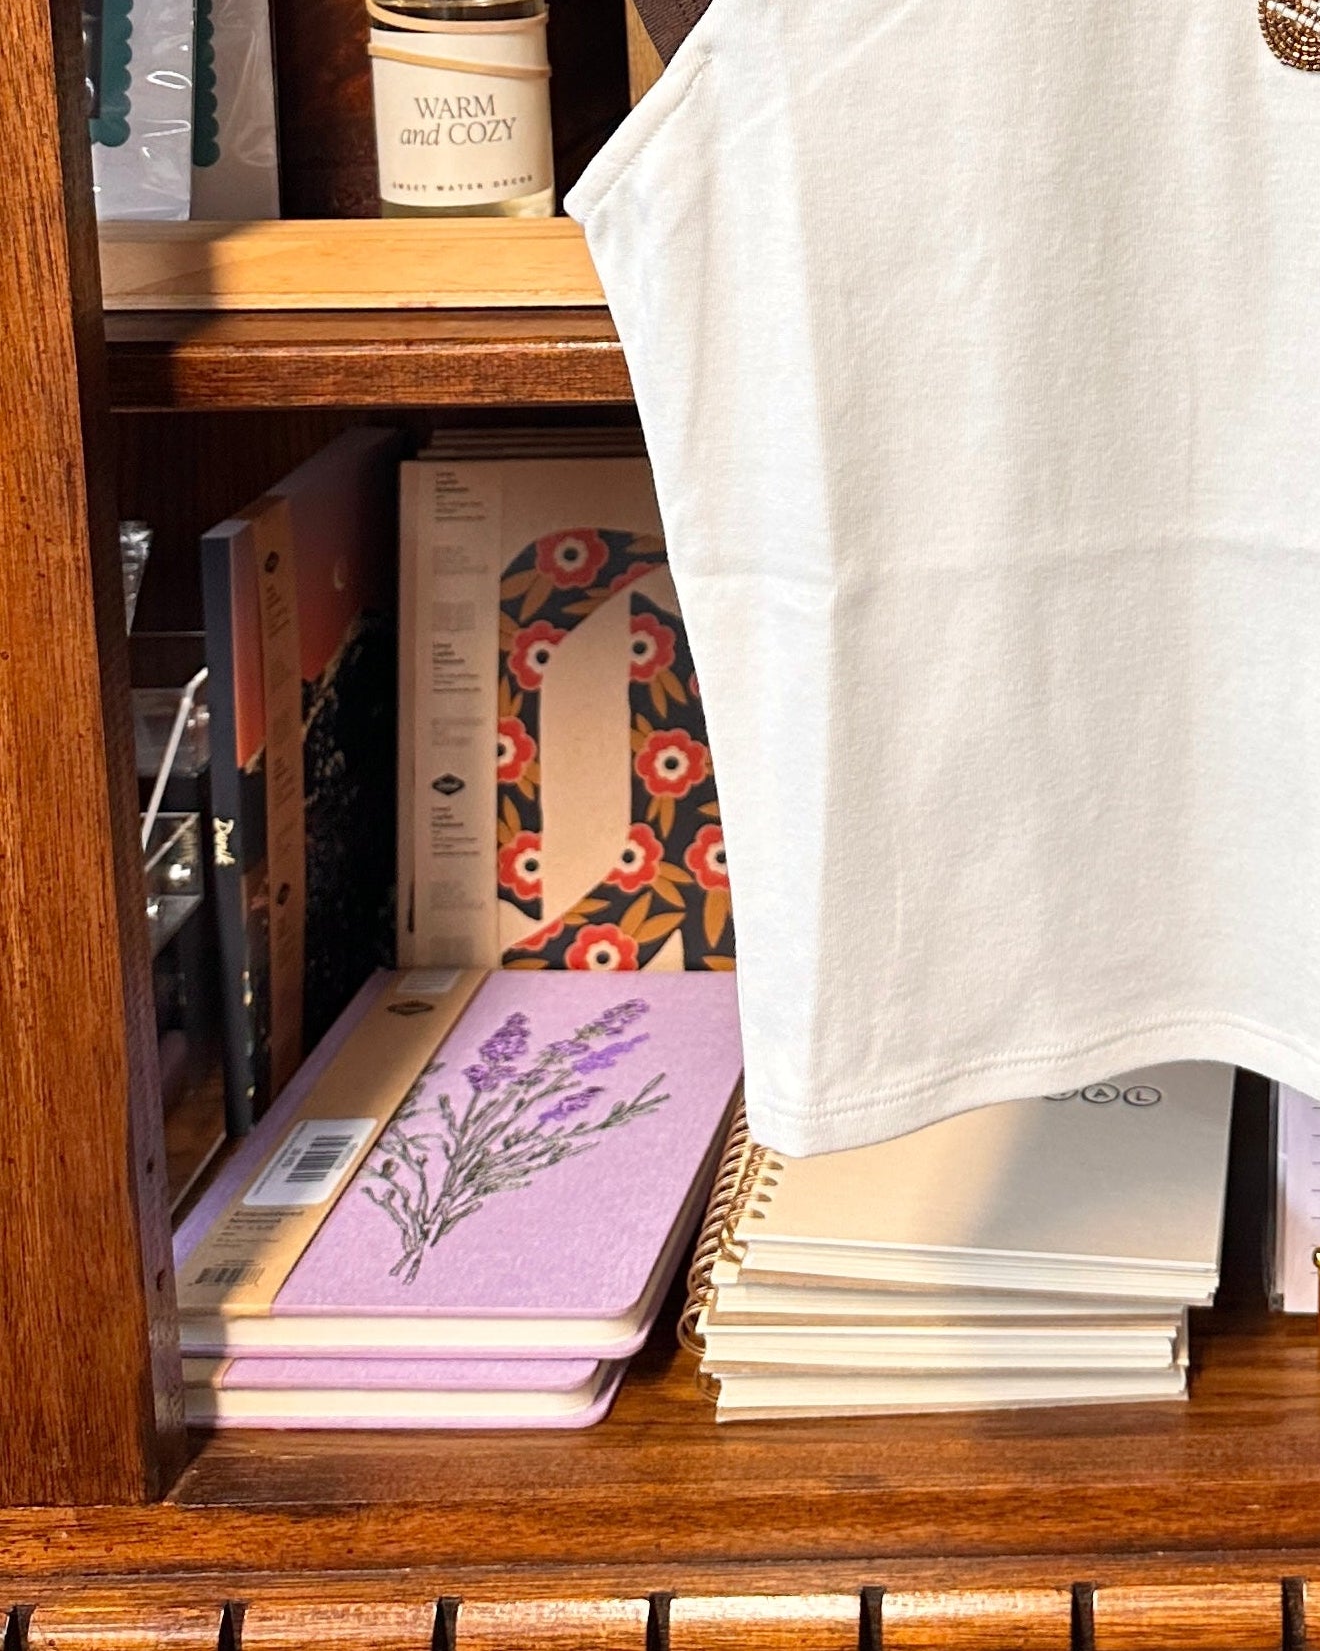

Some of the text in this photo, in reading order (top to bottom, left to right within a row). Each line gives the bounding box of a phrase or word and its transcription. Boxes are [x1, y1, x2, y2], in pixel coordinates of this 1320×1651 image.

[414, 93, 496, 121] WARM
[400, 116, 518, 147] and COZY
[436, 182, 484, 192] WATER
